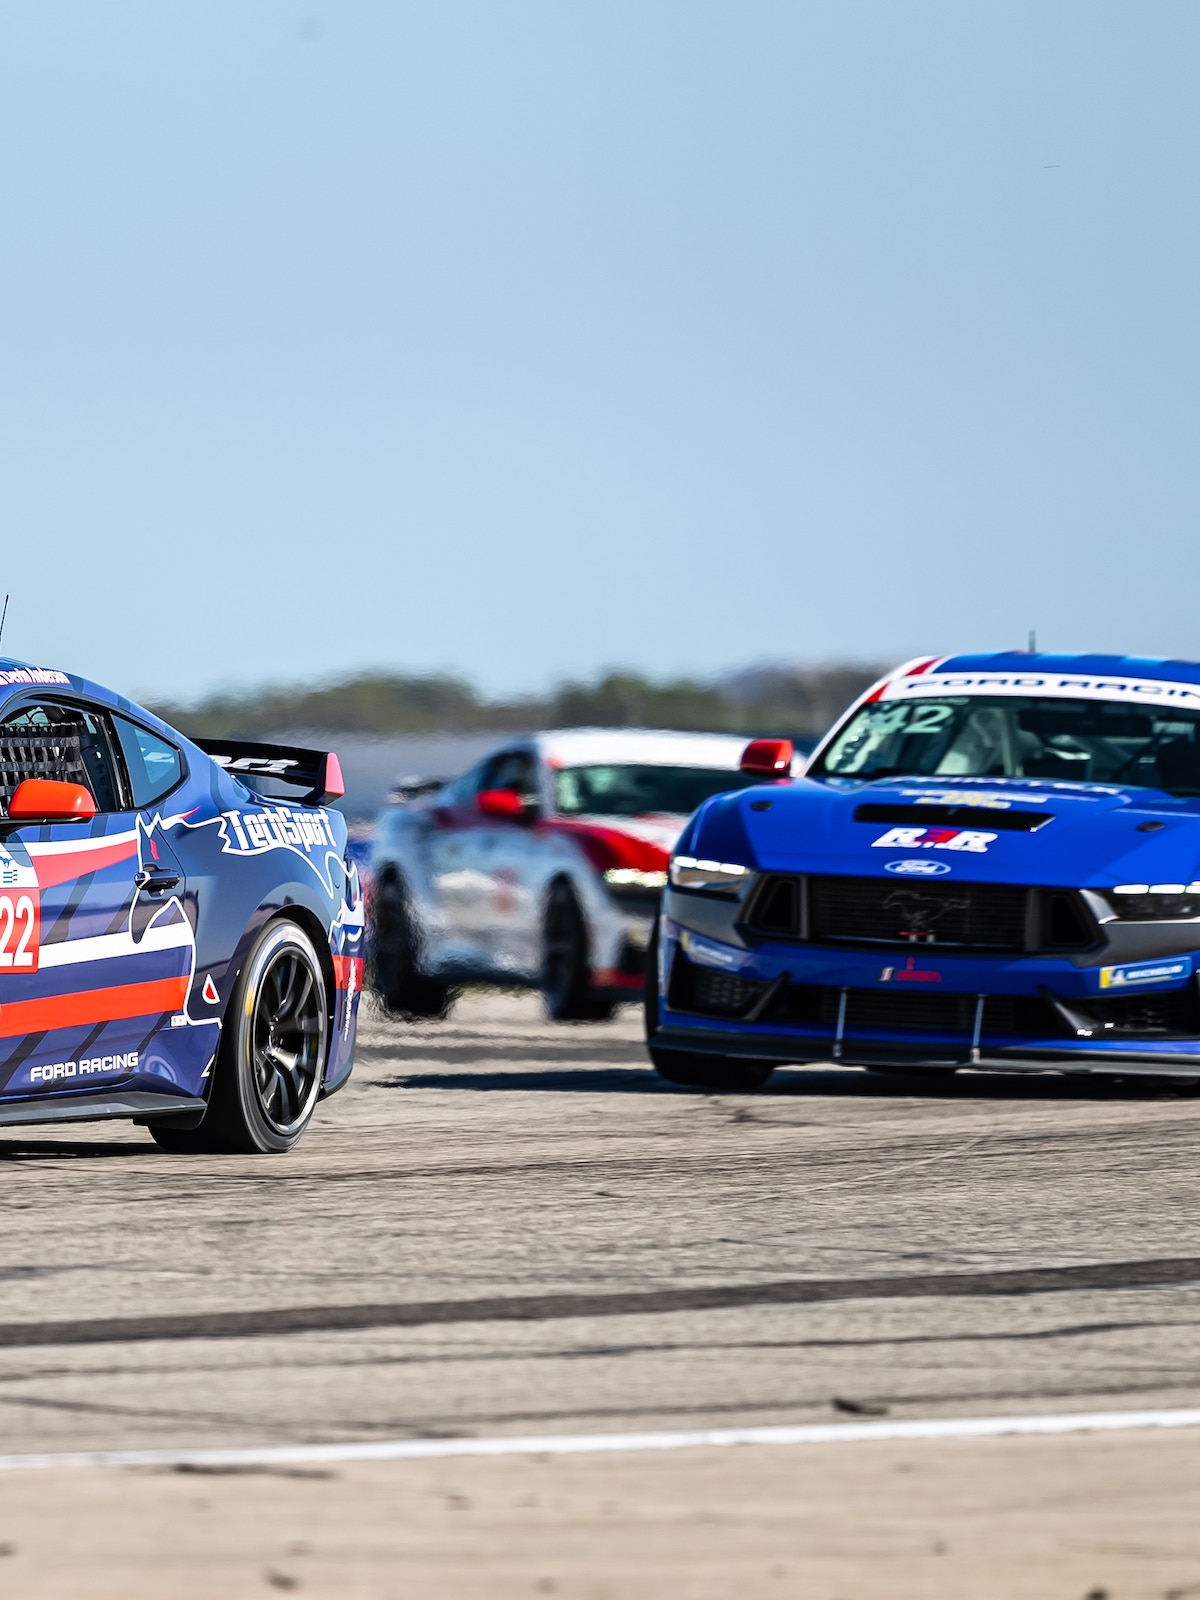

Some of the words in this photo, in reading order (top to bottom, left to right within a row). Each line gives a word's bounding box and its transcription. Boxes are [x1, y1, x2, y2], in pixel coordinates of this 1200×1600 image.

[907, 679, 1046, 689] FORD
[1059, 680, 1200, 697] RACIN
[222, 806, 337, 852] TechSport
[30, 1061, 77, 1082] FORD
[79, 1051, 139, 1075] RACING
